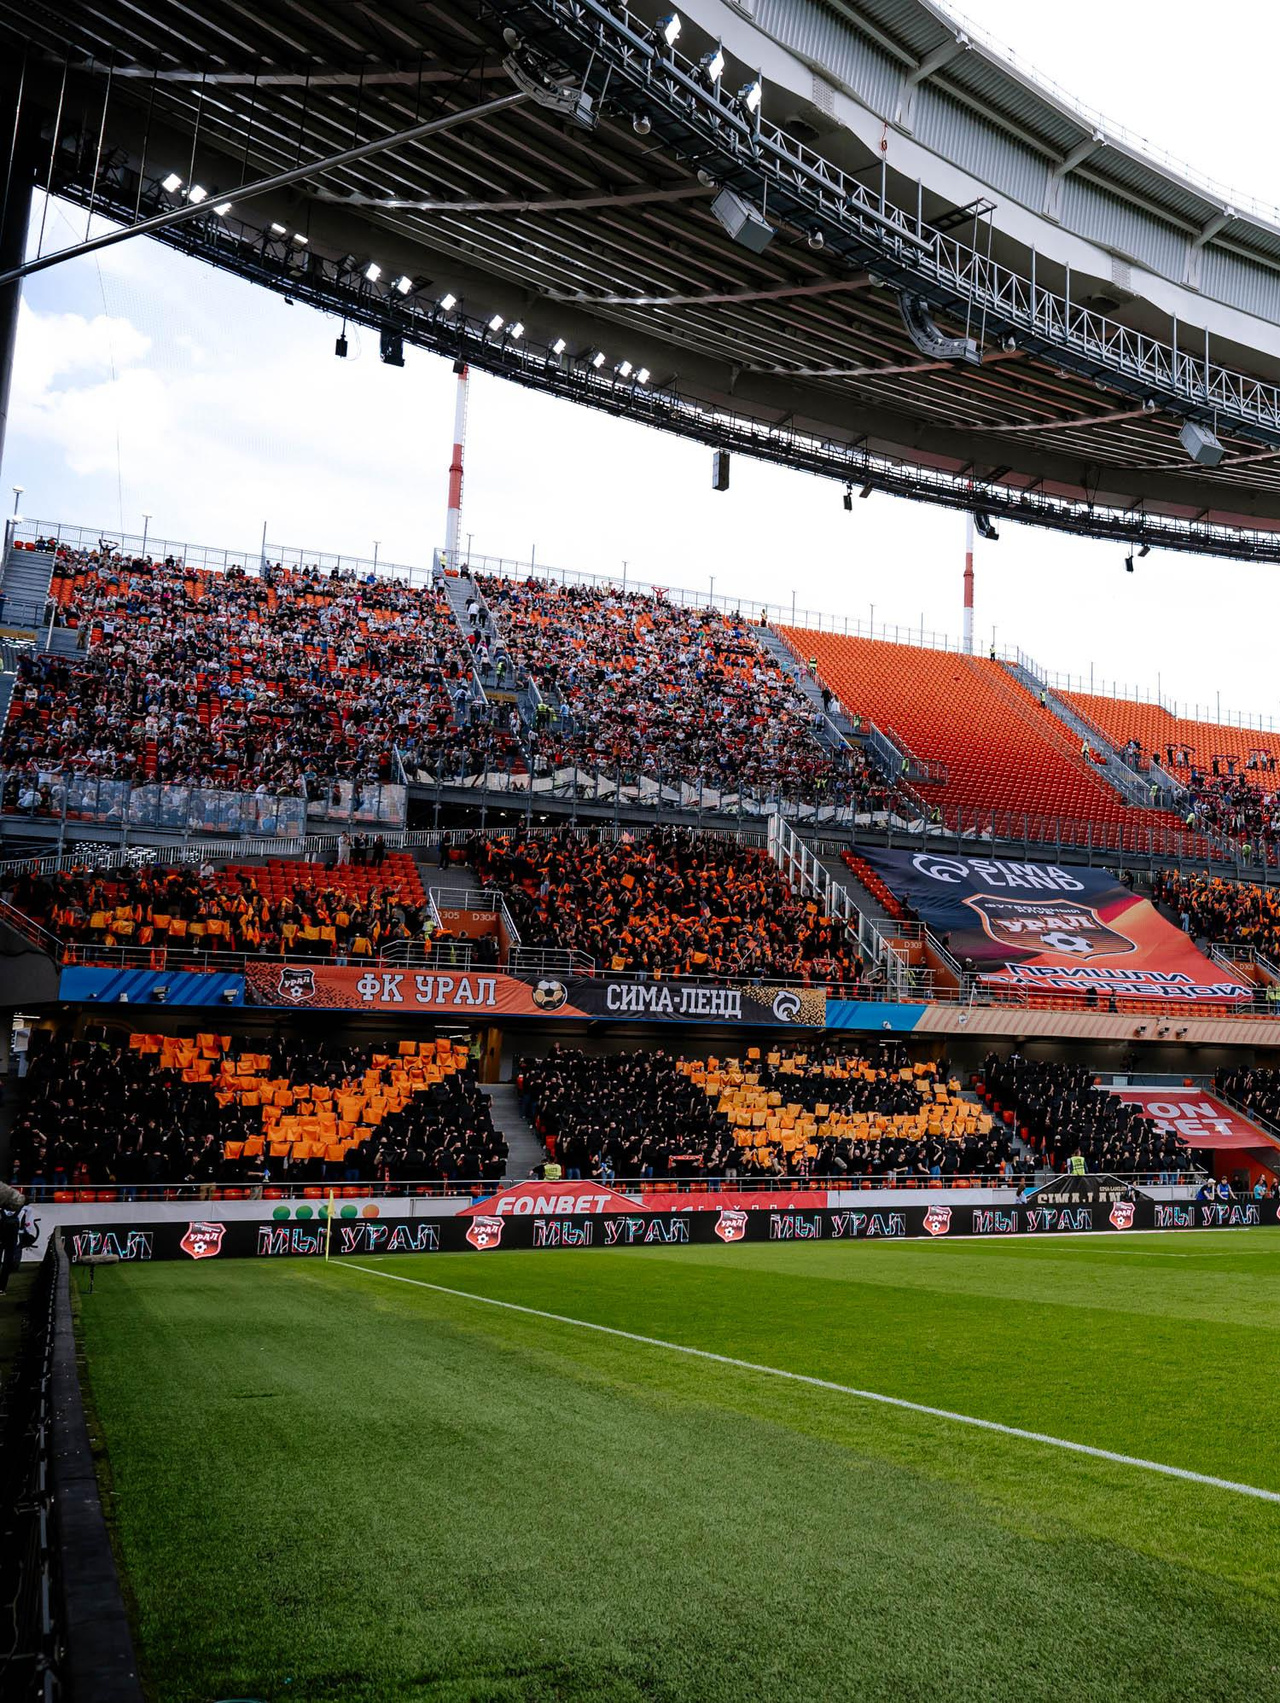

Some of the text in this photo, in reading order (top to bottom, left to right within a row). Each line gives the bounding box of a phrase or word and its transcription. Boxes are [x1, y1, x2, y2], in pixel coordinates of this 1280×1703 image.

[967, 859, 1074, 879] SIMA
[978, 872, 1085, 891] LAND
[993, 914, 1099, 933] УРАЛ
[284, 976, 310, 987] УРАЛ
[1004, 962, 1196, 984] ПРИШЛИ
[356, 973, 497, 1006] ФК УРАЛ
[1048, 978, 1254, 998] ПОБЕДОЙ
[606, 984, 742, 1019] СИМА-ЛЕНД
[495, 1195, 612, 1216] FONBET
[1154, 1203, 1260, 1226] МЫ УРАЛ
[472, 1225, 499, 1234] УРАЛ
[721, 1219, 744, 1228] УРАЛ
[770, 1211, 906, 1239] МЫ УРАЛ
[972, 1207, 1092, 1233] МЫ УРАЛ
[190, 1232, 219, 1242] УРАЛ
[341, 1223, 441, 1252] УРАЛ
[533, 1216, 690, 1246] МЫ УРАЛ
